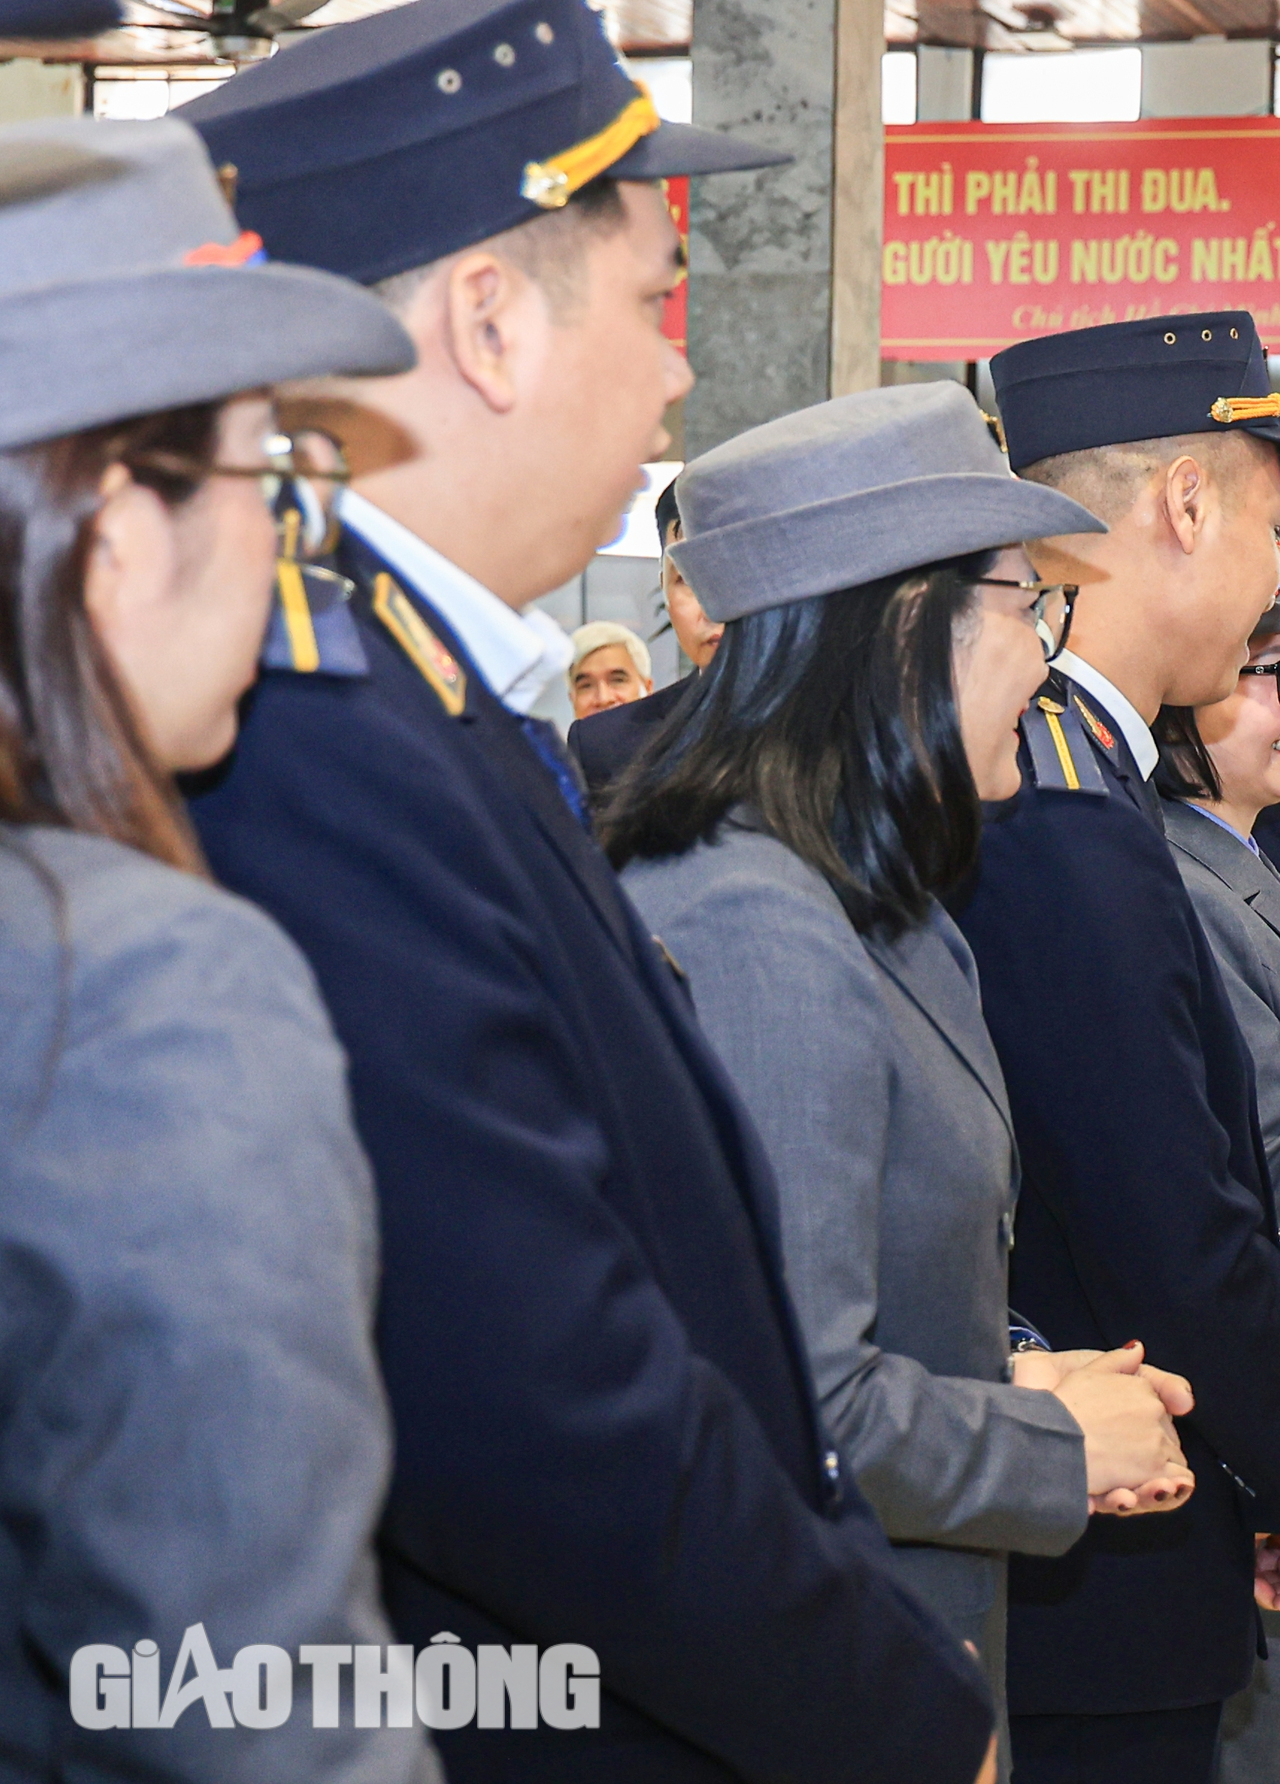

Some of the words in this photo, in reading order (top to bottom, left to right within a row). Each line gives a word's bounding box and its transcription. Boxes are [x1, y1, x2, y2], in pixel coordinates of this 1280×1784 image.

[893, 161, 954, 216] THÌ
[965, 155, 1058, 216] PHẢI
[1068, 167, 1129, 214] THI
[883, 229, 973, 284] GƯỜI
[985, 231, 1059, 284] YÊU
[1070, 225, 1179, 283] NƯỚC
